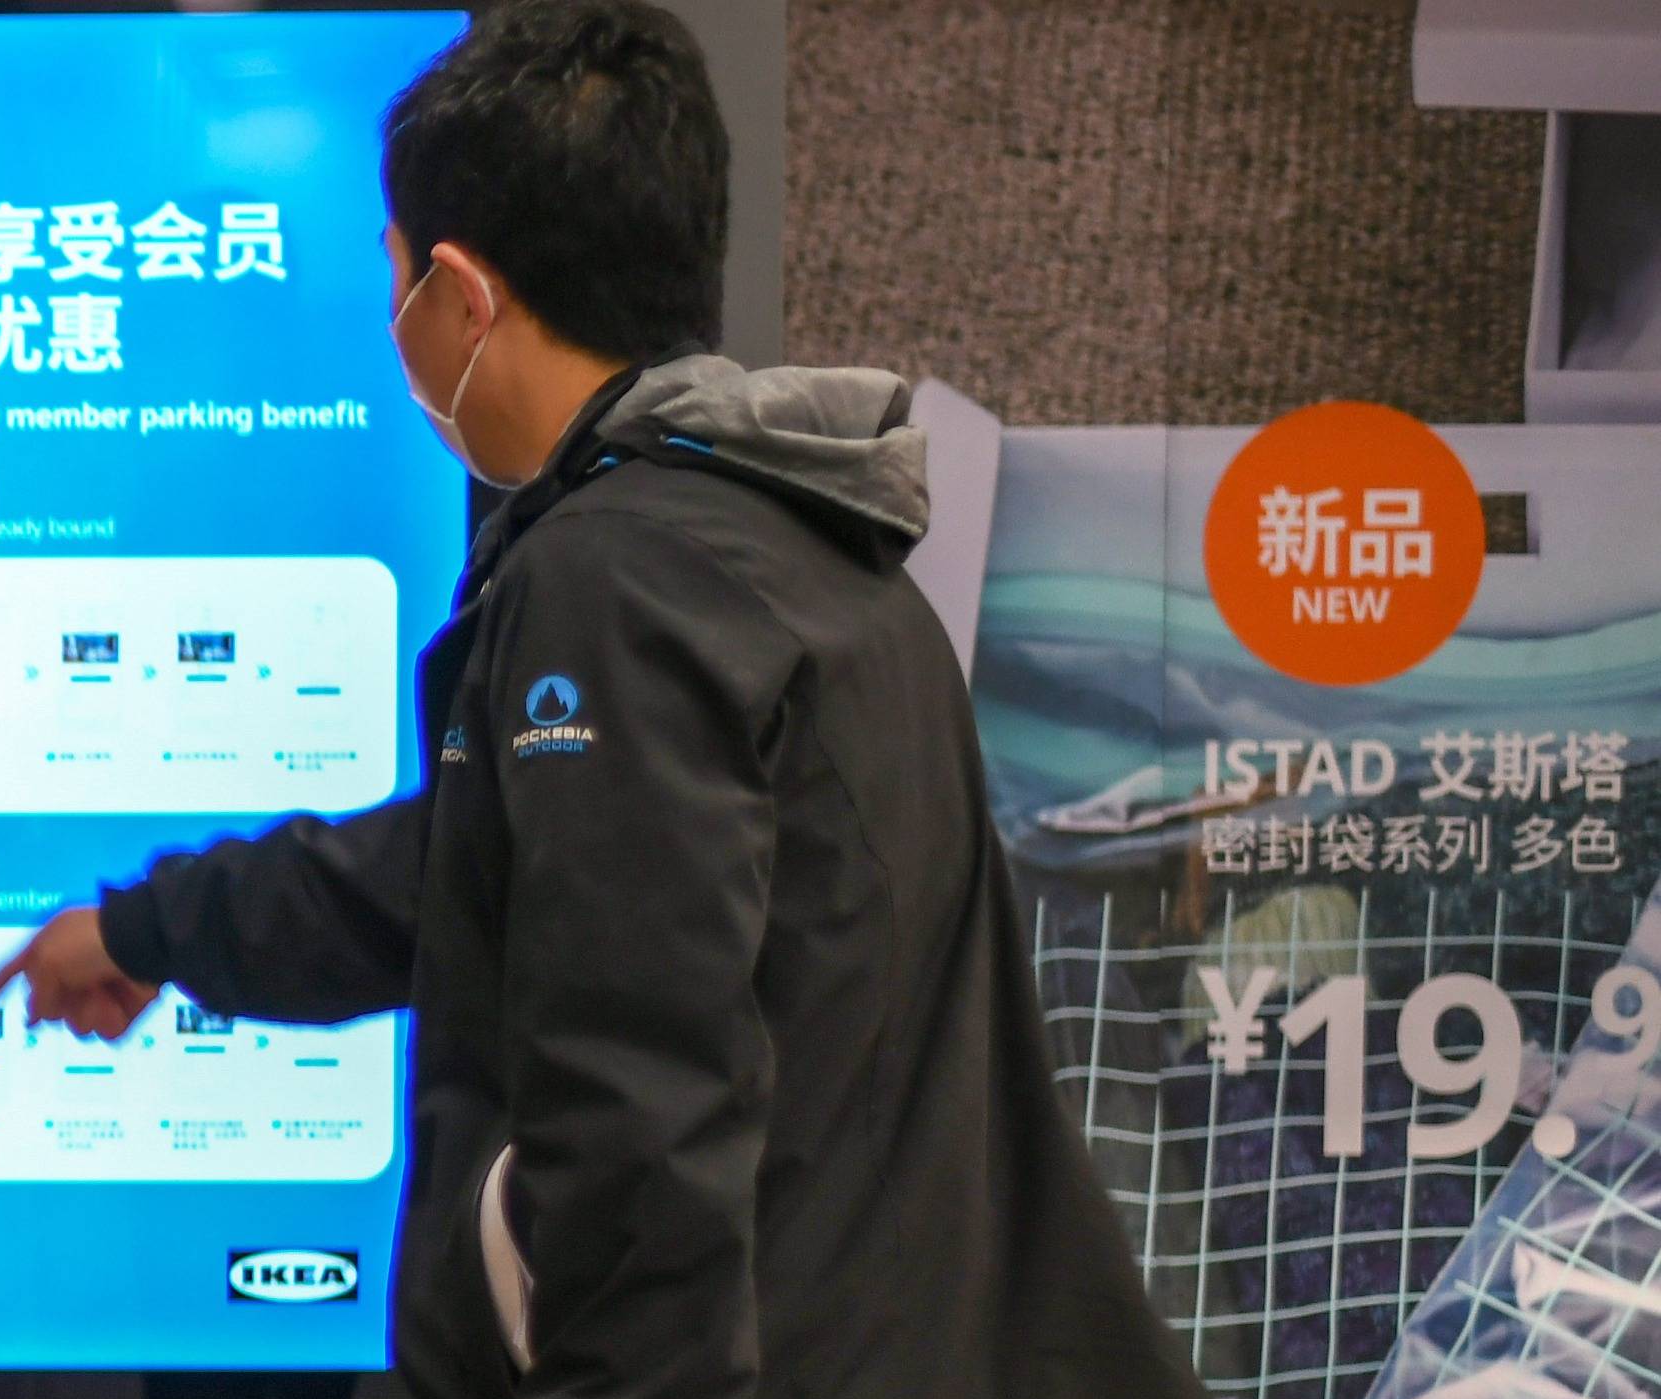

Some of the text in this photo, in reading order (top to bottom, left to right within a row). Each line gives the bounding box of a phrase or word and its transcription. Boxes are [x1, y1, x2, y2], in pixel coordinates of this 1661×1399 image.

[6, 401, 131, 430] member
[140, 400, 254, 438] parking
[261, 399, 368, 430] benefit
[48, 516, 115, 540] bound
[1258, 485, 1434, 578] 新品
[1292, 586, 1391, 624] NEW
[1205, 729, 1628, 801] ISTAD 艾斯塔
[1202, 813, 1622, 876] 密封袋系列 多色
[242, 1265, 347, 1285] IKEA
